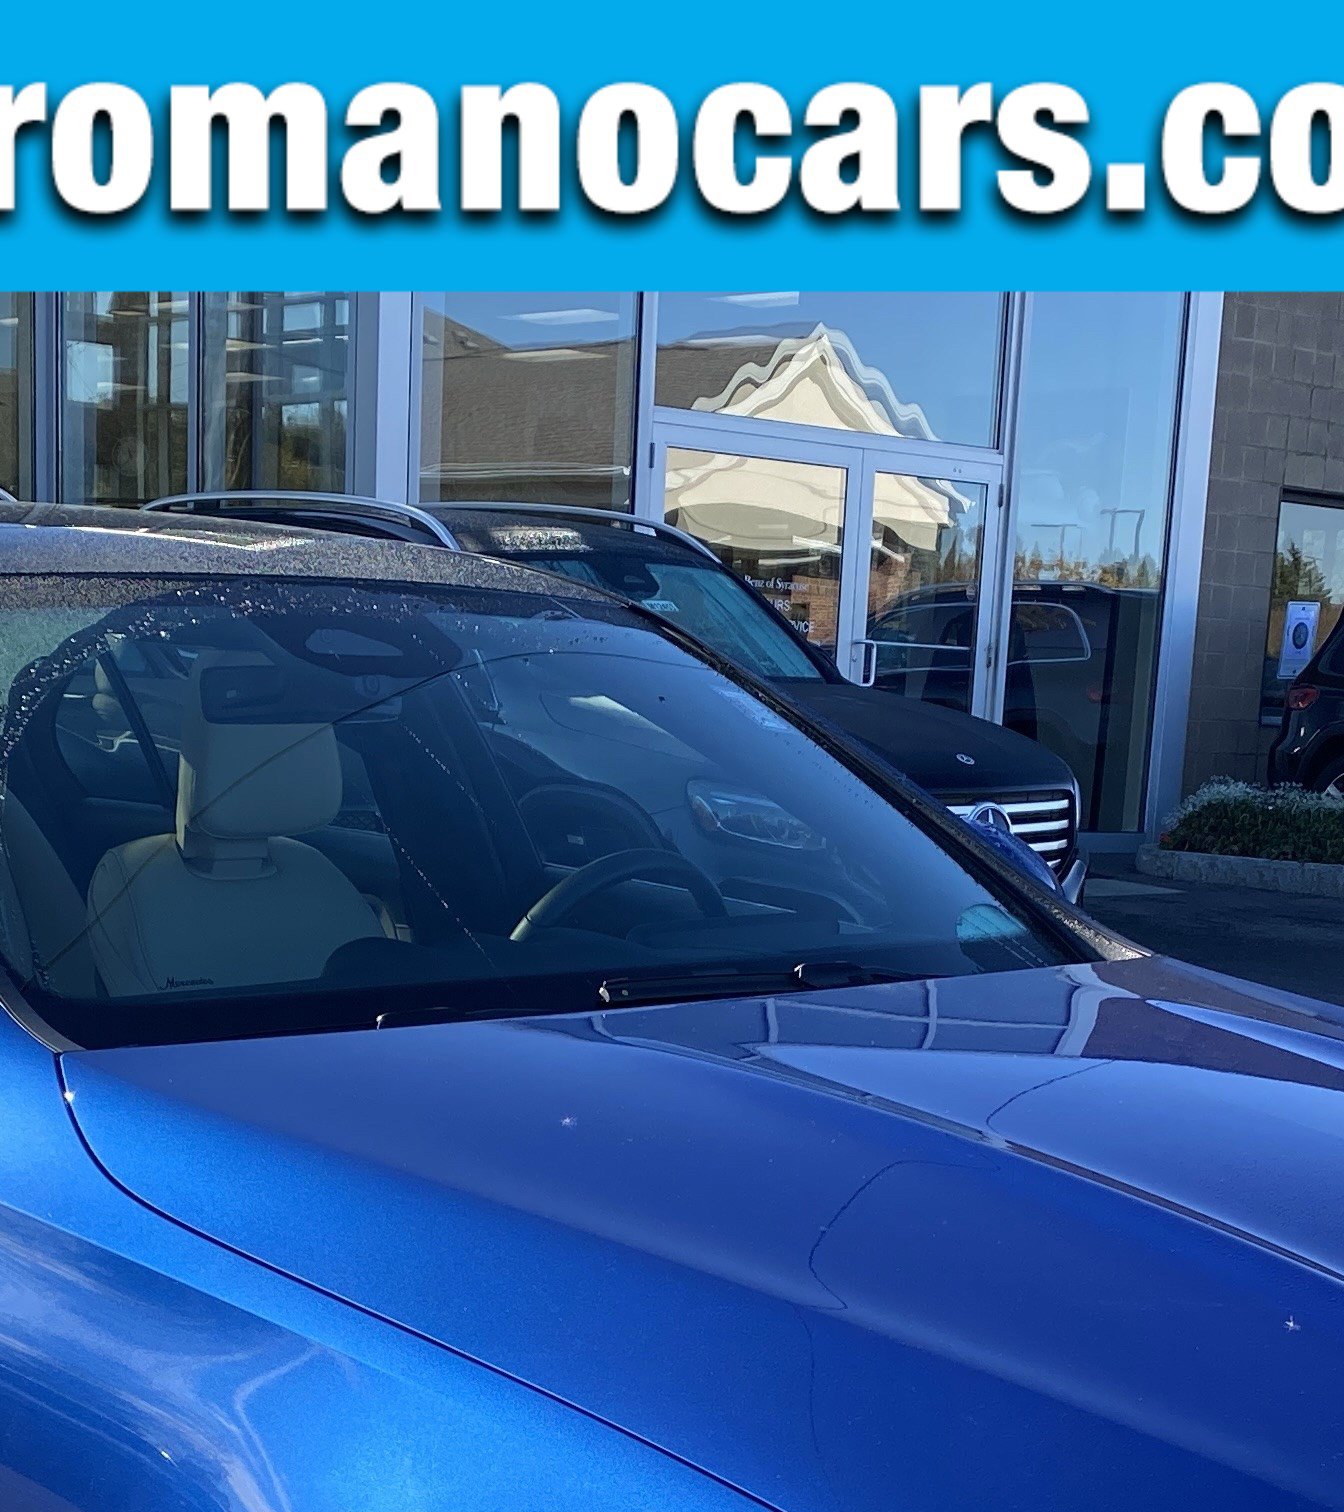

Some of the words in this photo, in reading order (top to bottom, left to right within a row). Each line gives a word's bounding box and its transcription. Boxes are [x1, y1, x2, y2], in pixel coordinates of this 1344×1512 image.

[766, 577, 775, 589] of
[776, 577, 809, 592] Syracuse
[790, 619, 815, 634] VICE
